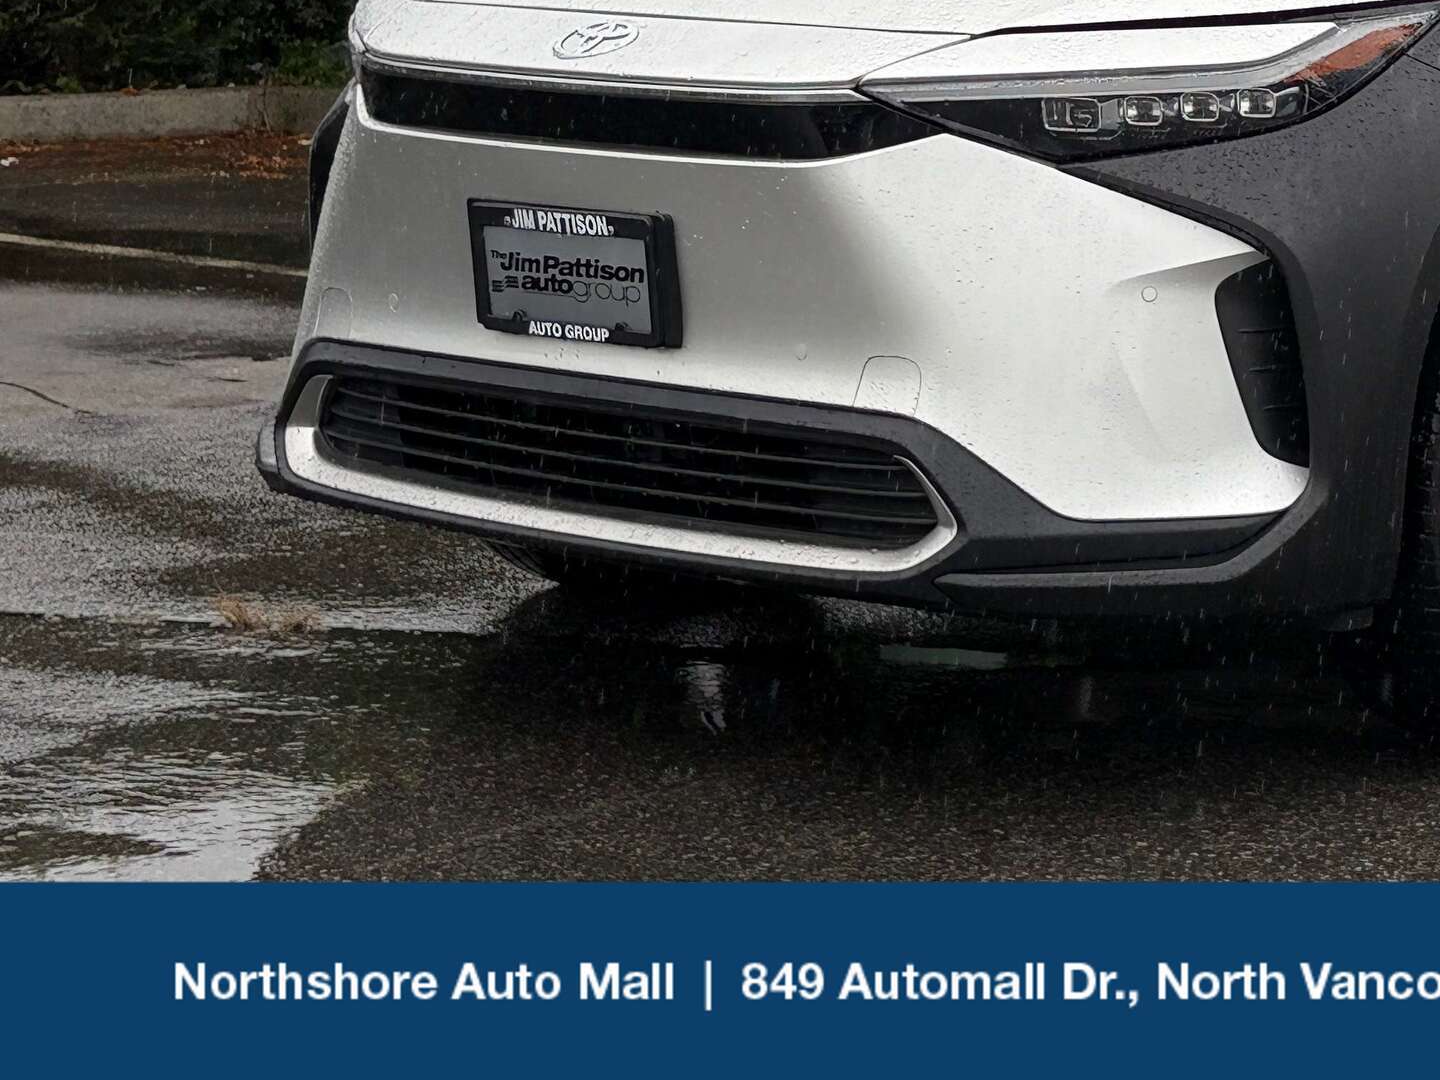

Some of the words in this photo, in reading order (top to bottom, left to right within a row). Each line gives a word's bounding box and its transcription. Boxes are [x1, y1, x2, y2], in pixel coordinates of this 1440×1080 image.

[512, 209, 535, 230] JIM
[537, 210, 608, 235] PATTISON
[500, 251, 541, 274] Jim
[542, 254, 645, 284] Pattison
[529, 320, 563, 339] AUTO
[564, 324, 610, 343] GROUP
